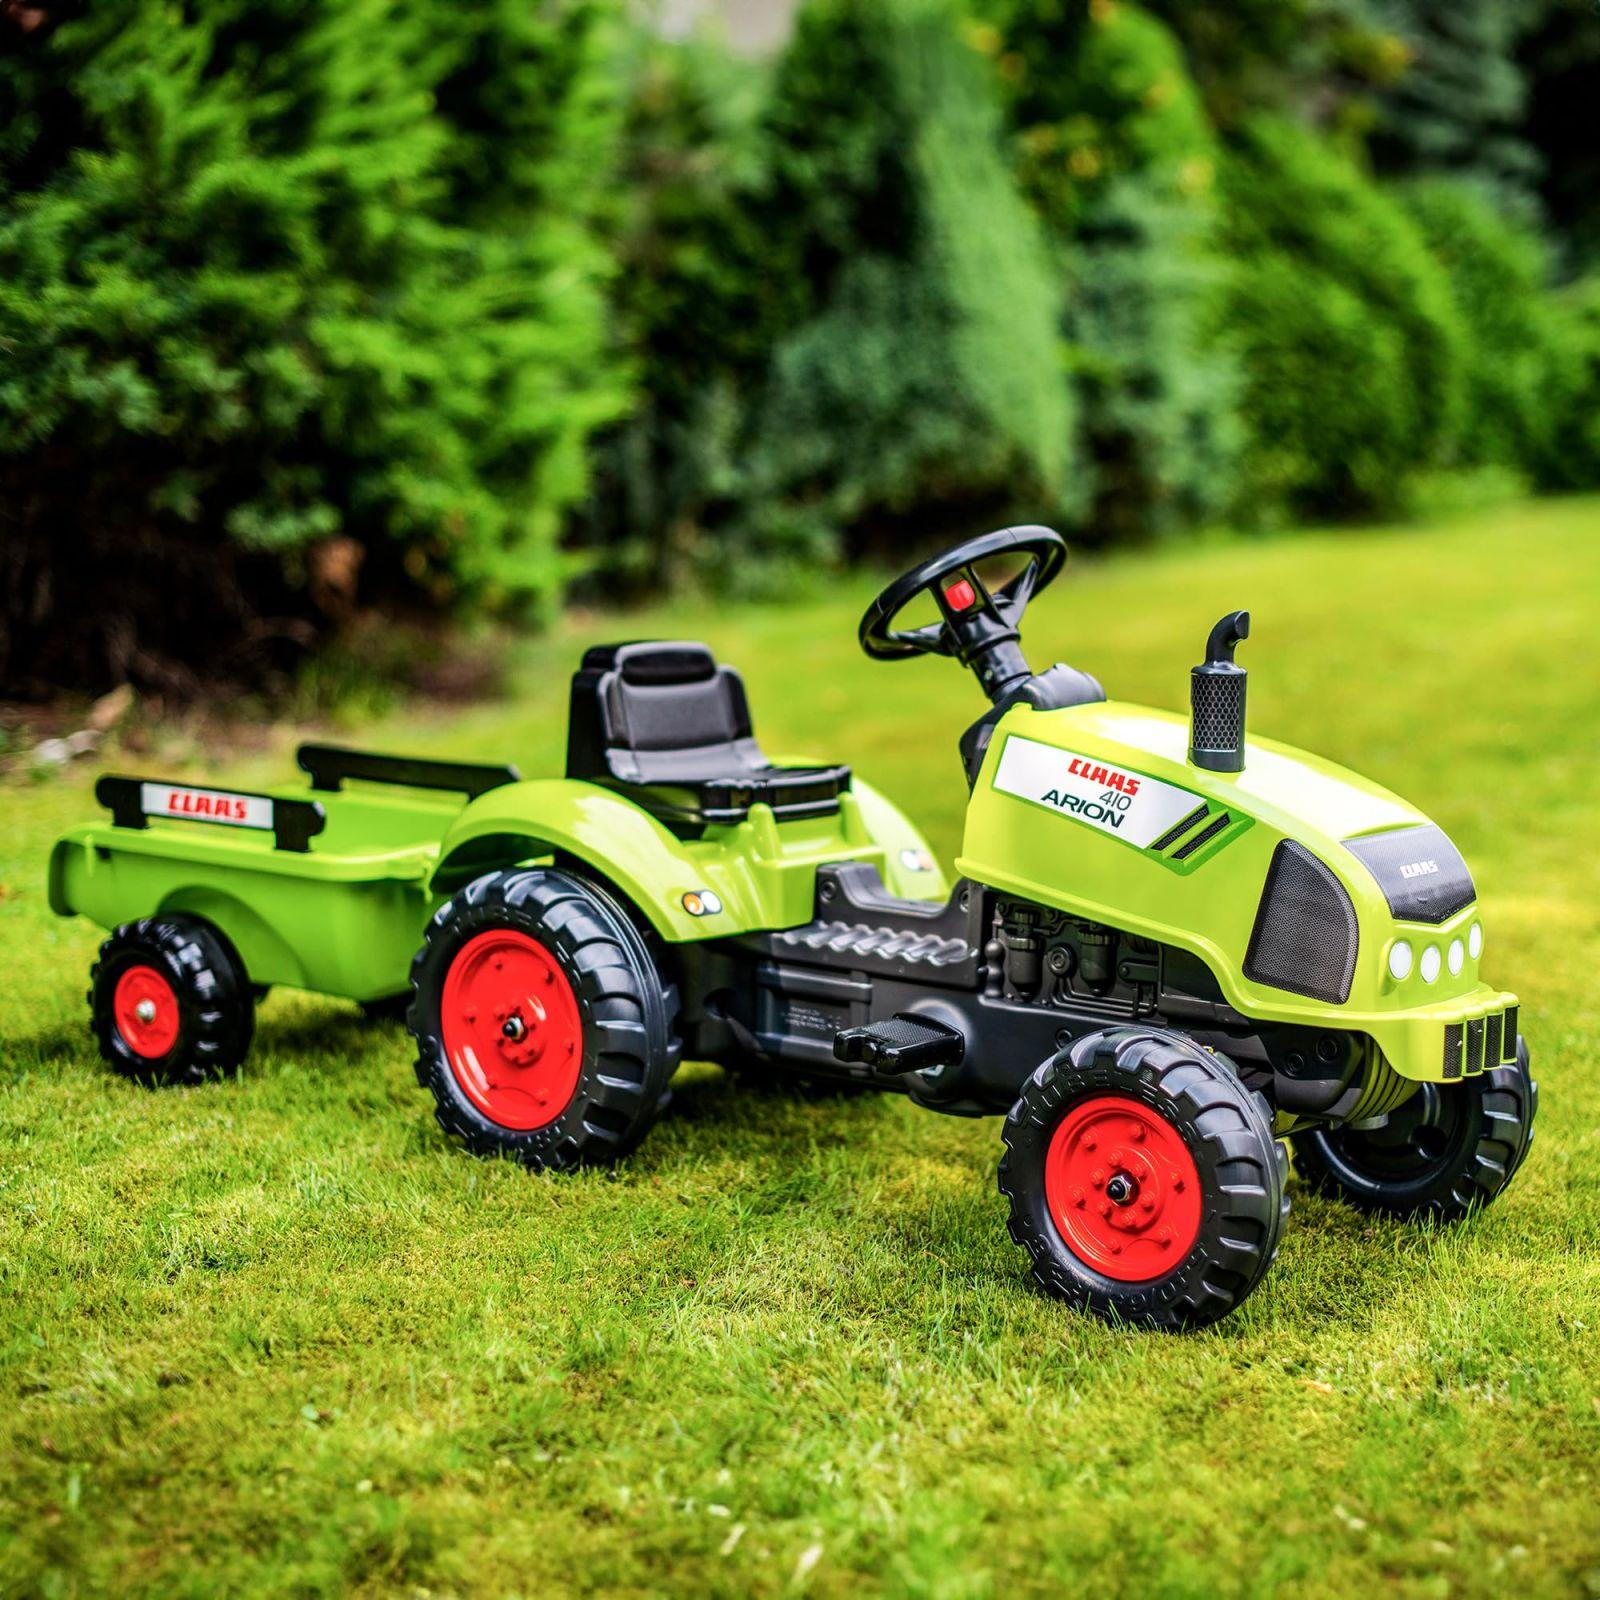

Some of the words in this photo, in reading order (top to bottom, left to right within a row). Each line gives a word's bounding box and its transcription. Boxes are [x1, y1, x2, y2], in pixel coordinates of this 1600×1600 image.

[1068, 758, 1141, 796] CLAAS
[168, 793, 248, 820] CLAAS
[1040, 789, 1126, 829] ARION
[1099, 791, 1133, 811] 410
[1400, 860, 1439, 879] CLAAS
